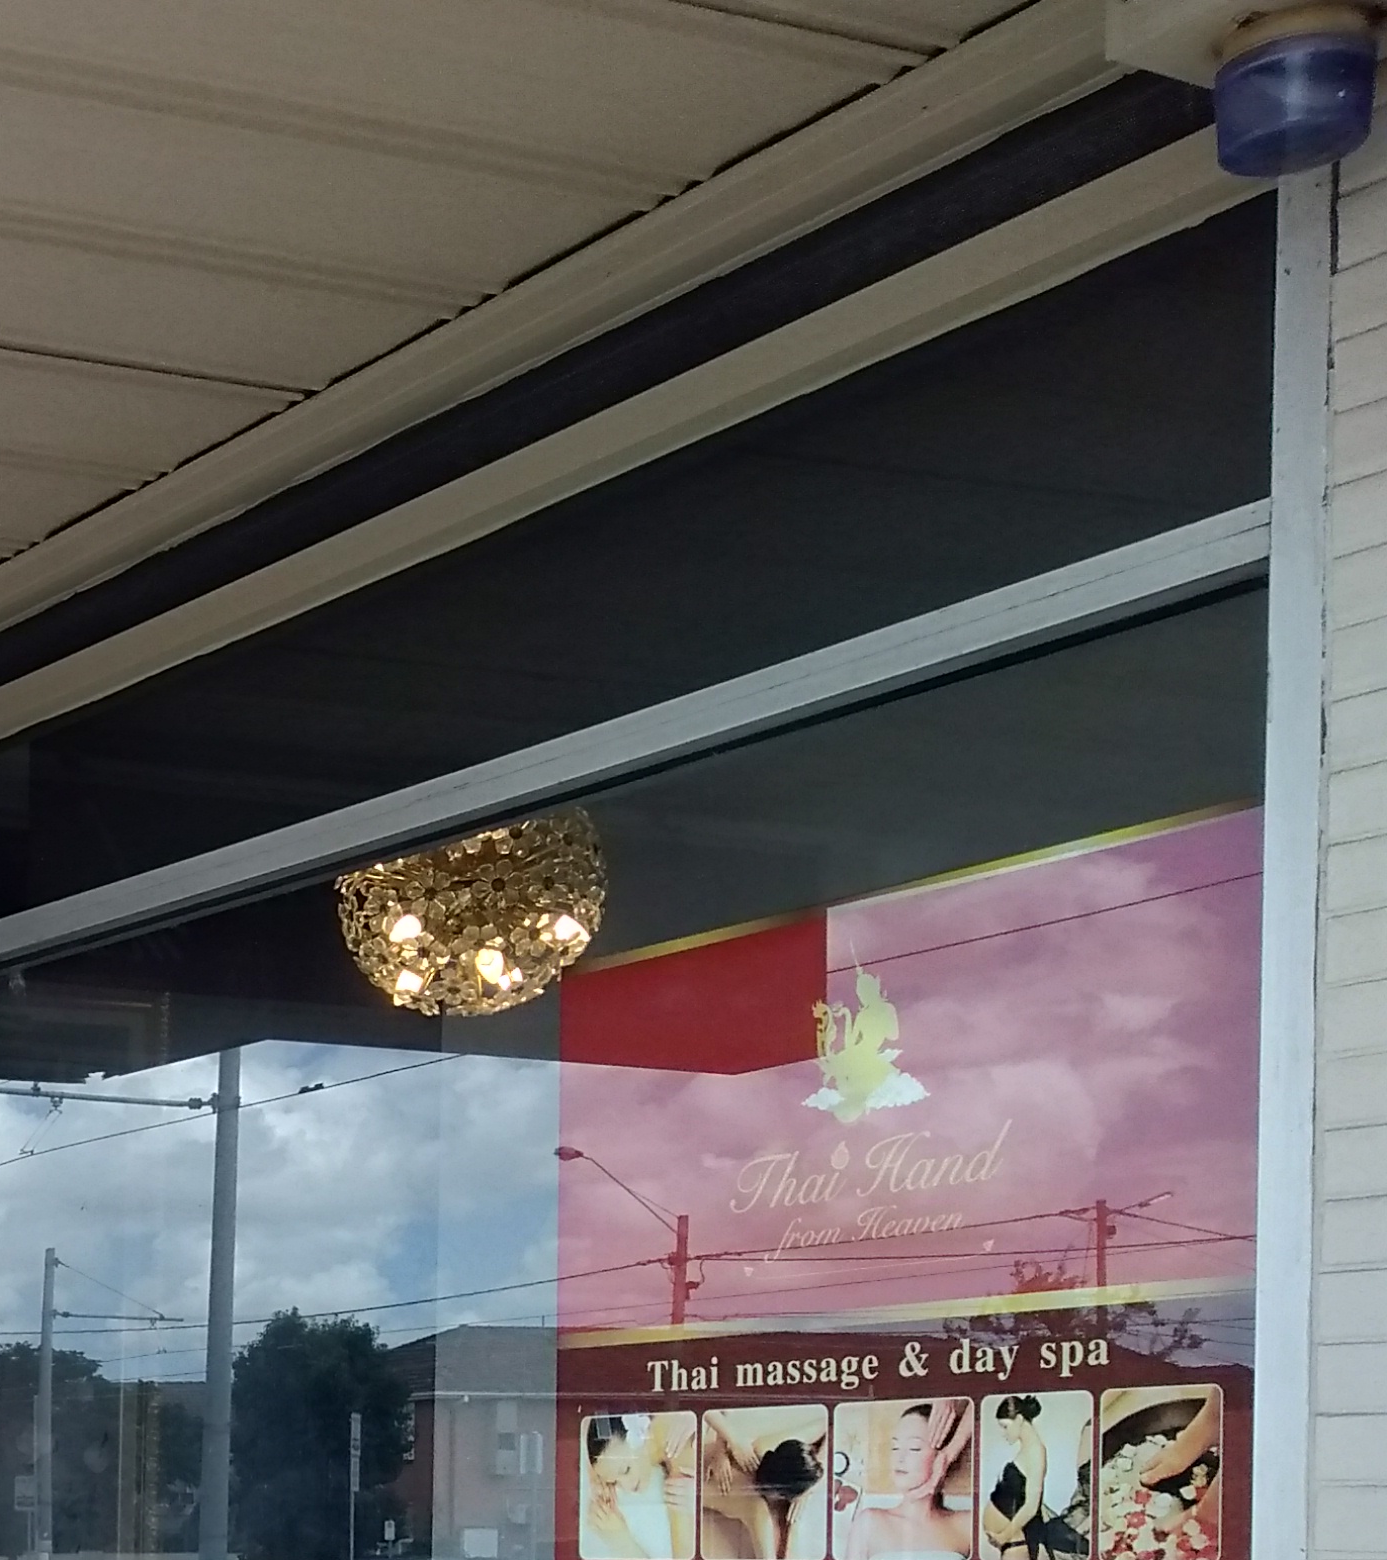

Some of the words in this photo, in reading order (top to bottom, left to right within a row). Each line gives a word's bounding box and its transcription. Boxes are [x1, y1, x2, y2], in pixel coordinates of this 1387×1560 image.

[730, 1141, 849, 1216] Thai
[856, 1118, 1013, 1200] Hand
[763, 1216, 841, 1263] from
[854, 1204, 964, 1243] Heaven
[647, 1354, 720, 1395] Thai
[735, 1350, 879, 1391] massage
[898, 1341, 930, 1377] &
[949, 1335, 1019, 1383] day
[1039, 1335, 1111, 1375] spa
